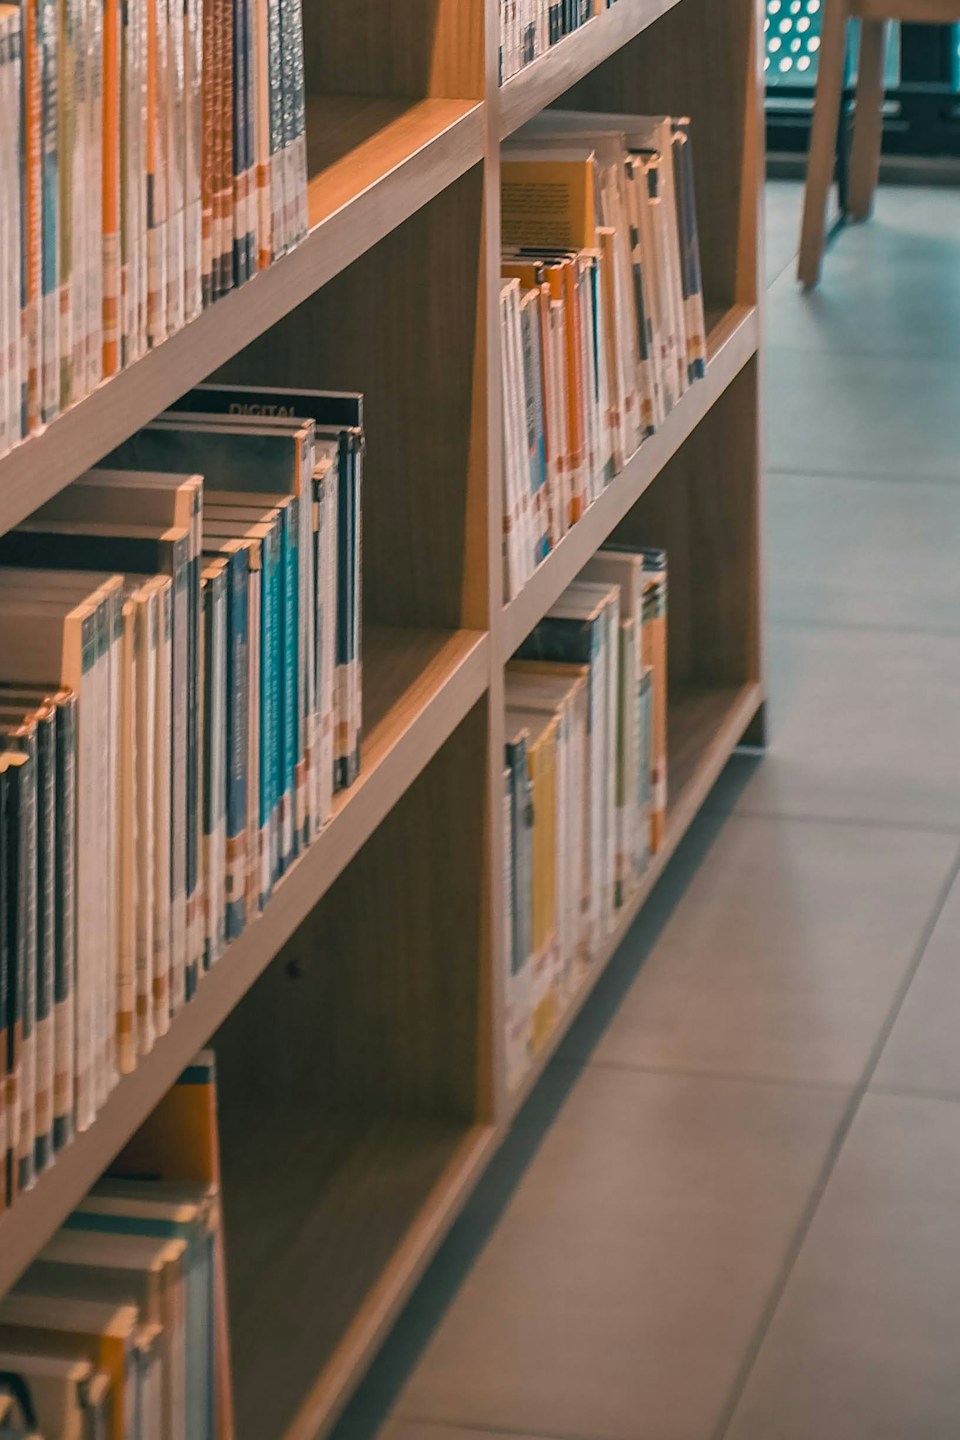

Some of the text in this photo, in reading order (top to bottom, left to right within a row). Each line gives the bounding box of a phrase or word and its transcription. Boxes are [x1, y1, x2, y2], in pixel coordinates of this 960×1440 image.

[205, 16, 214, 147] MARKETING
[213, 1, 223, 131] MARKETING
[224, 3, 233, 177] MARKETING 4.0
